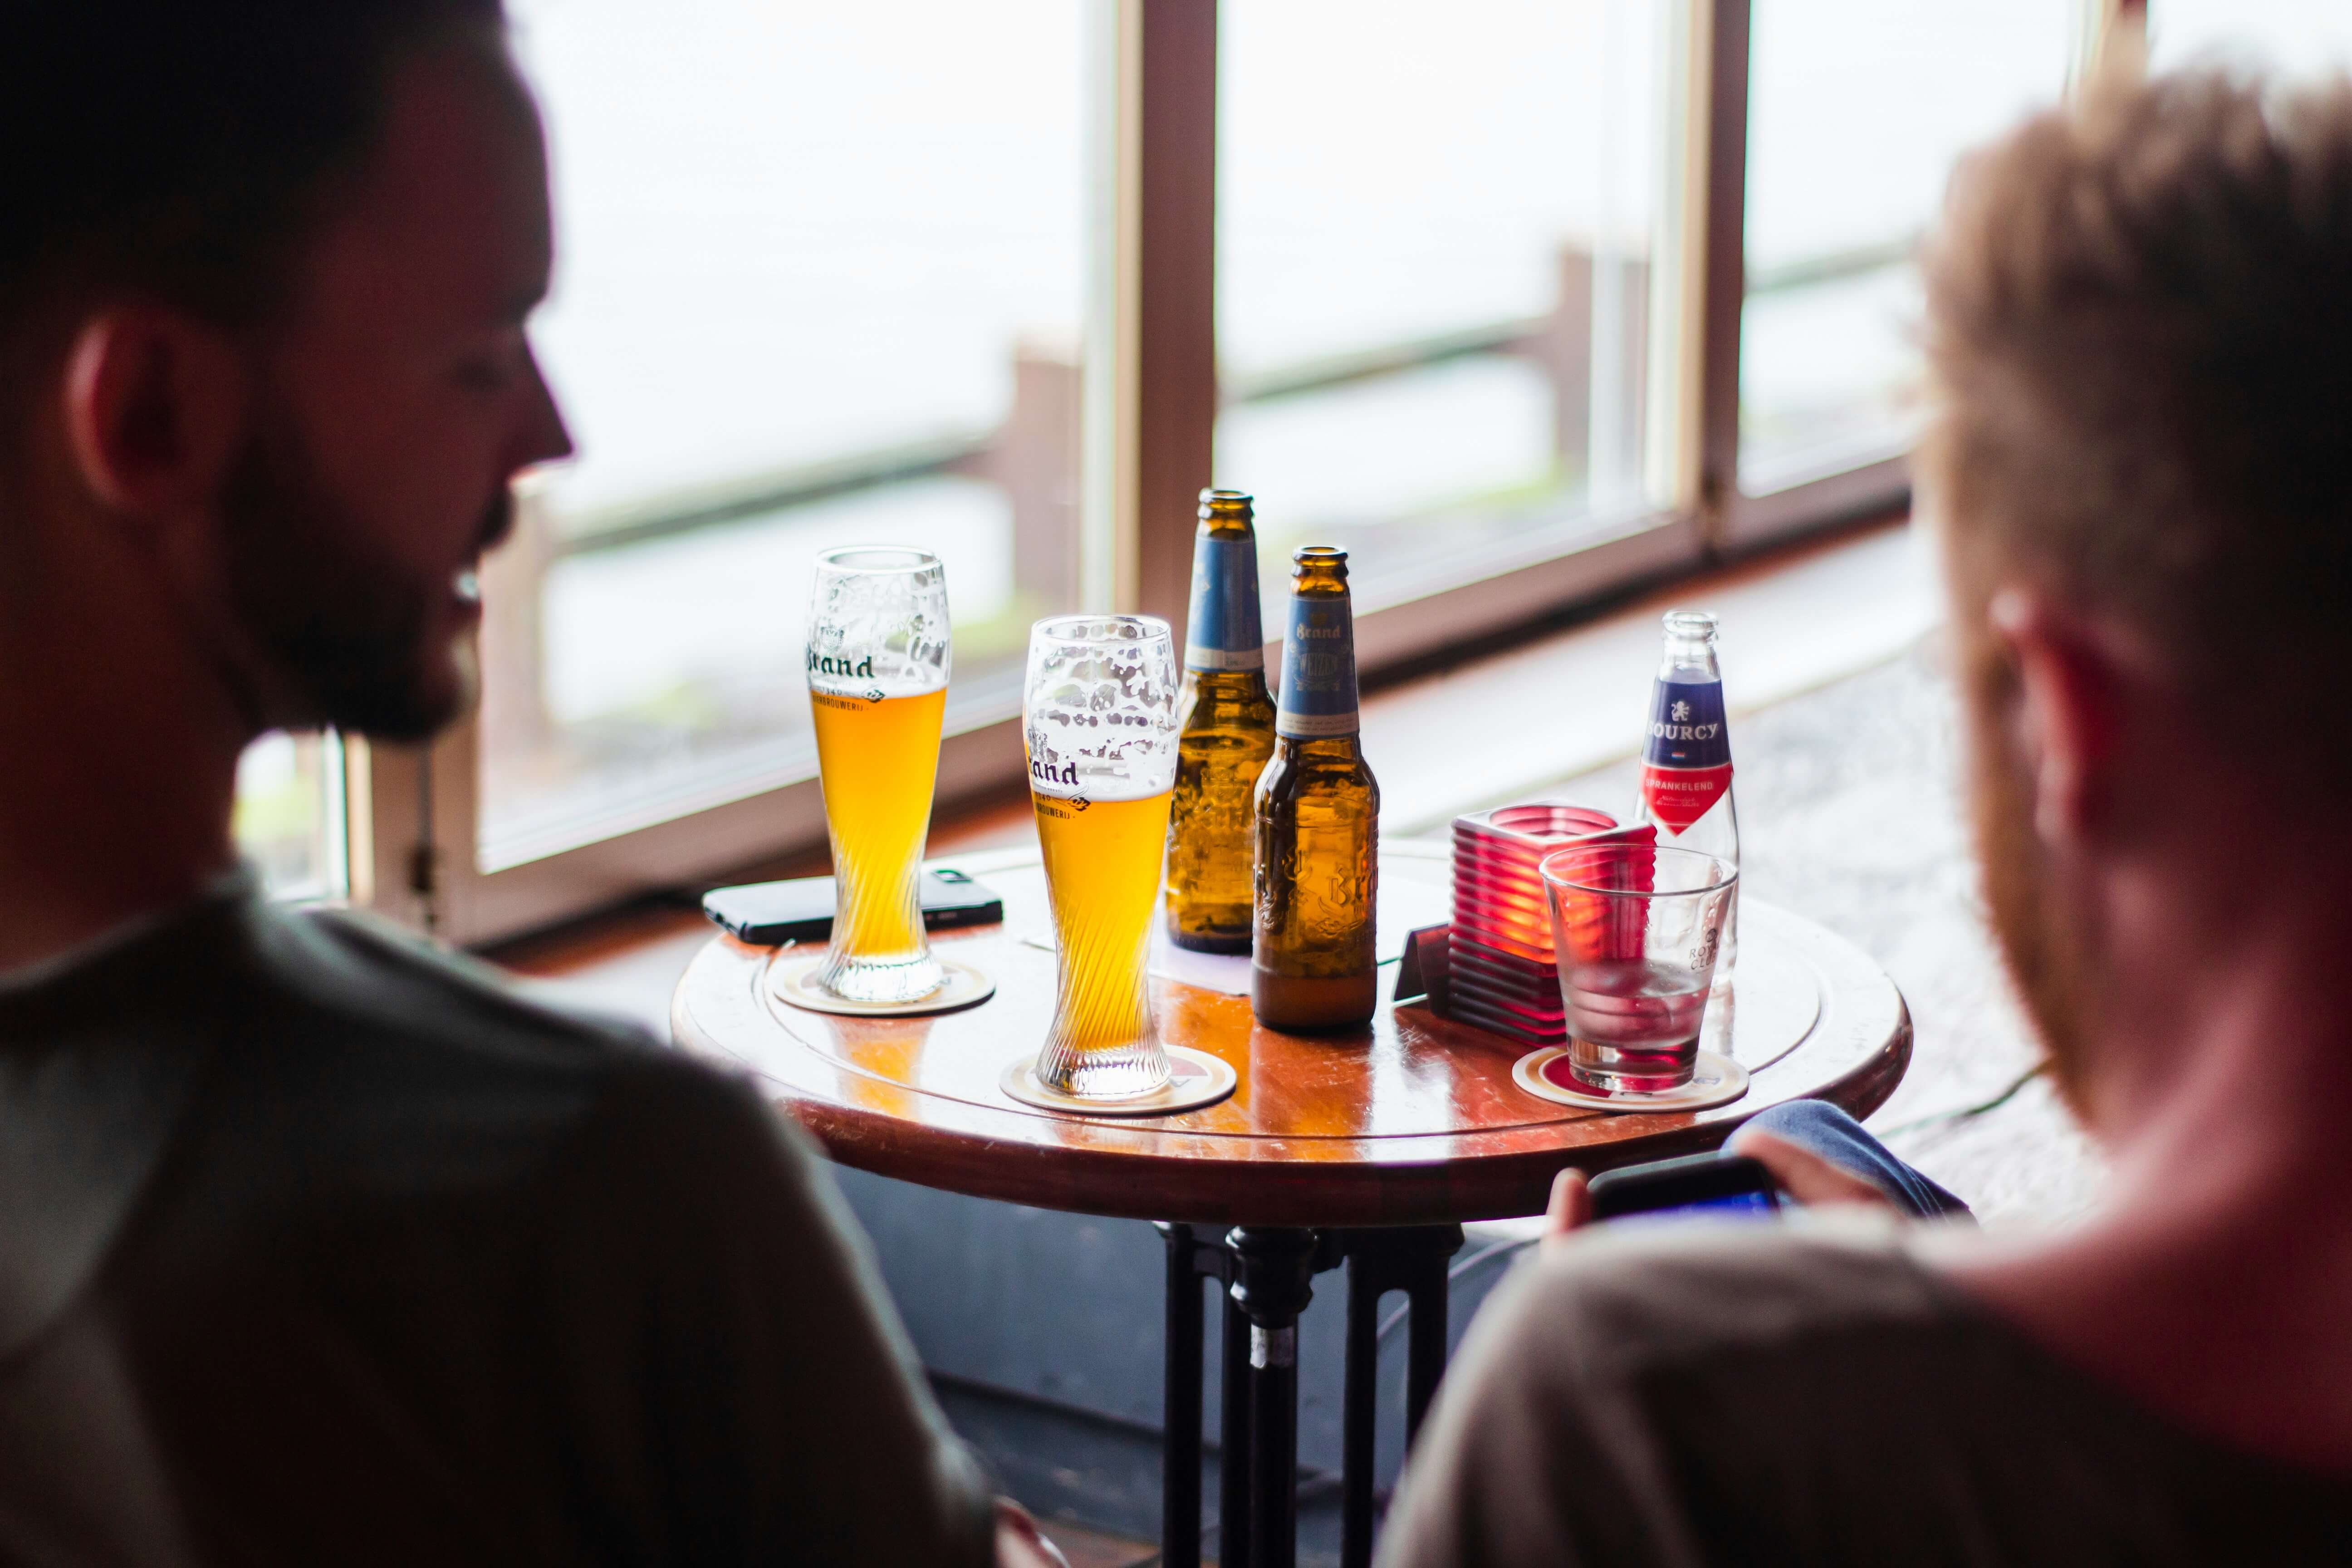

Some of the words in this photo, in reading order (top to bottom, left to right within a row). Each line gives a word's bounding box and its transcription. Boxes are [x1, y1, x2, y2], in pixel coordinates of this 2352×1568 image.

[1297, 624, 1340, 640] Brand
[1647, 720, 1718, 740] SOURCY
[1030, 756, 1079, 786] and
[1645, 778, 1714, 791] SPRANKELEND
